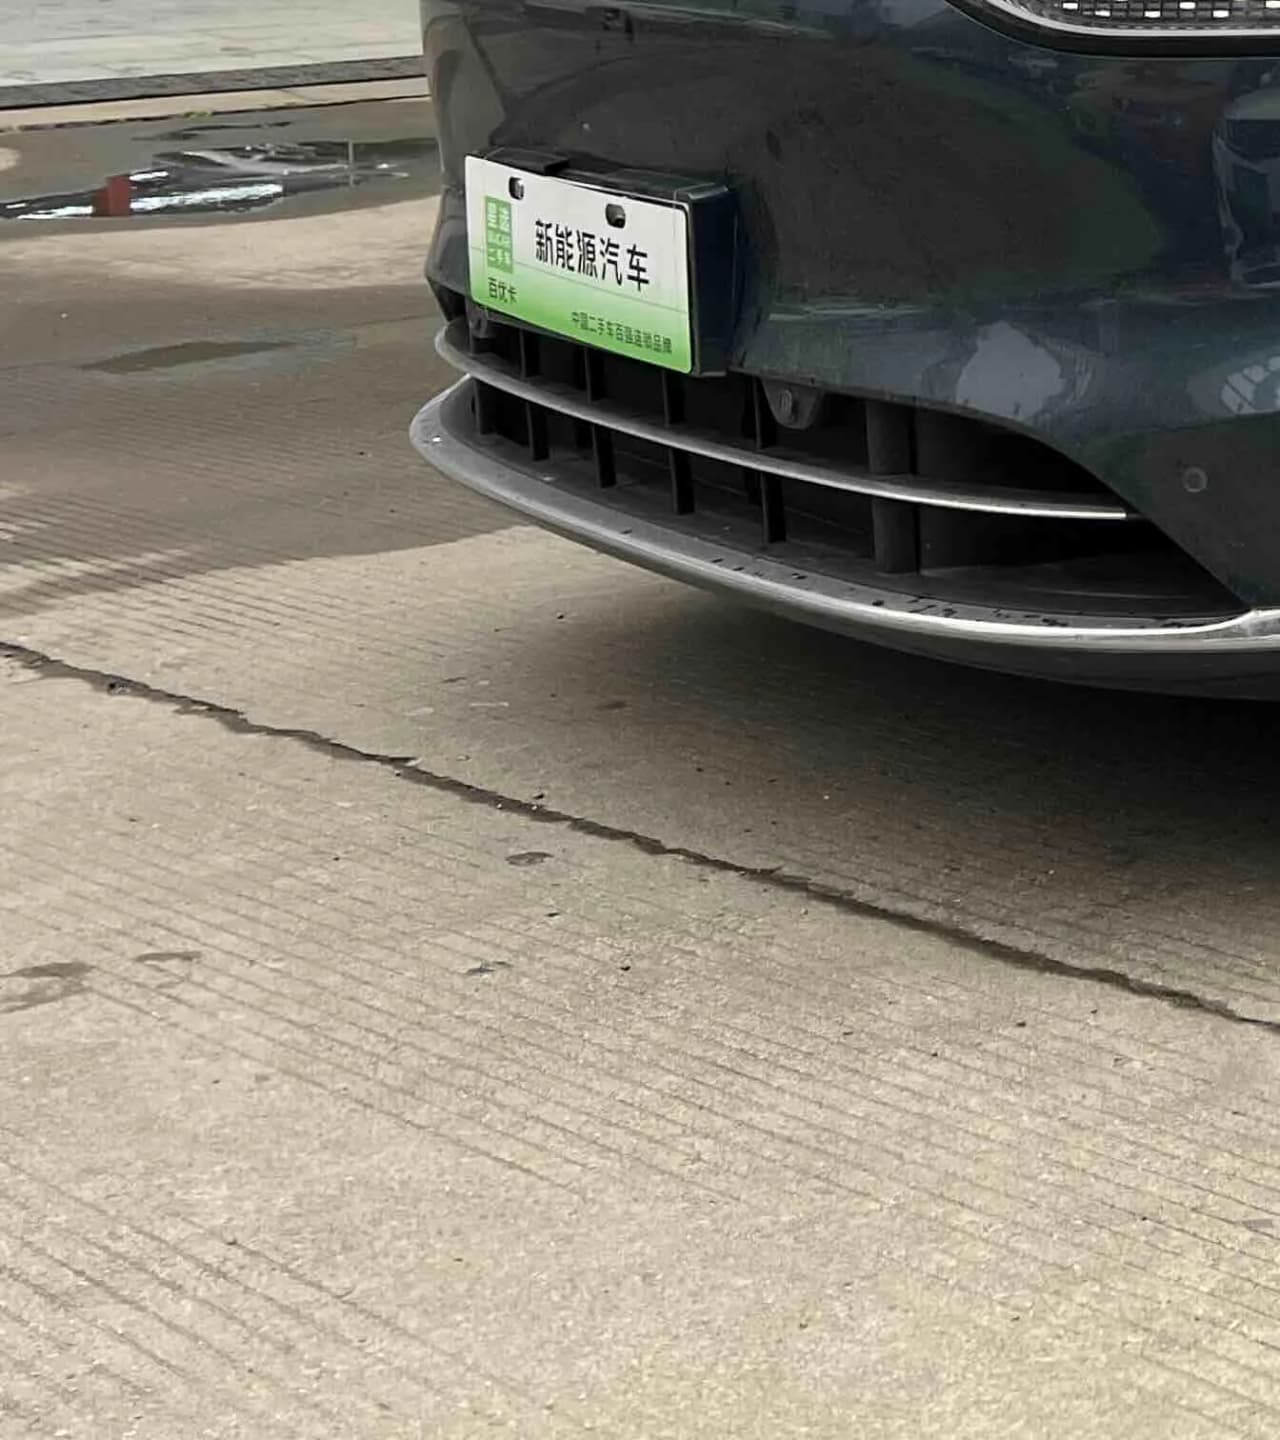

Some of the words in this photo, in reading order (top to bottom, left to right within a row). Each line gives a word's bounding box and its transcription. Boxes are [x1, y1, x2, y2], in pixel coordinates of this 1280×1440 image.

[535, 218, 650, 291] 新能源汽车
[487, 276, 518, 304] 百优卡
